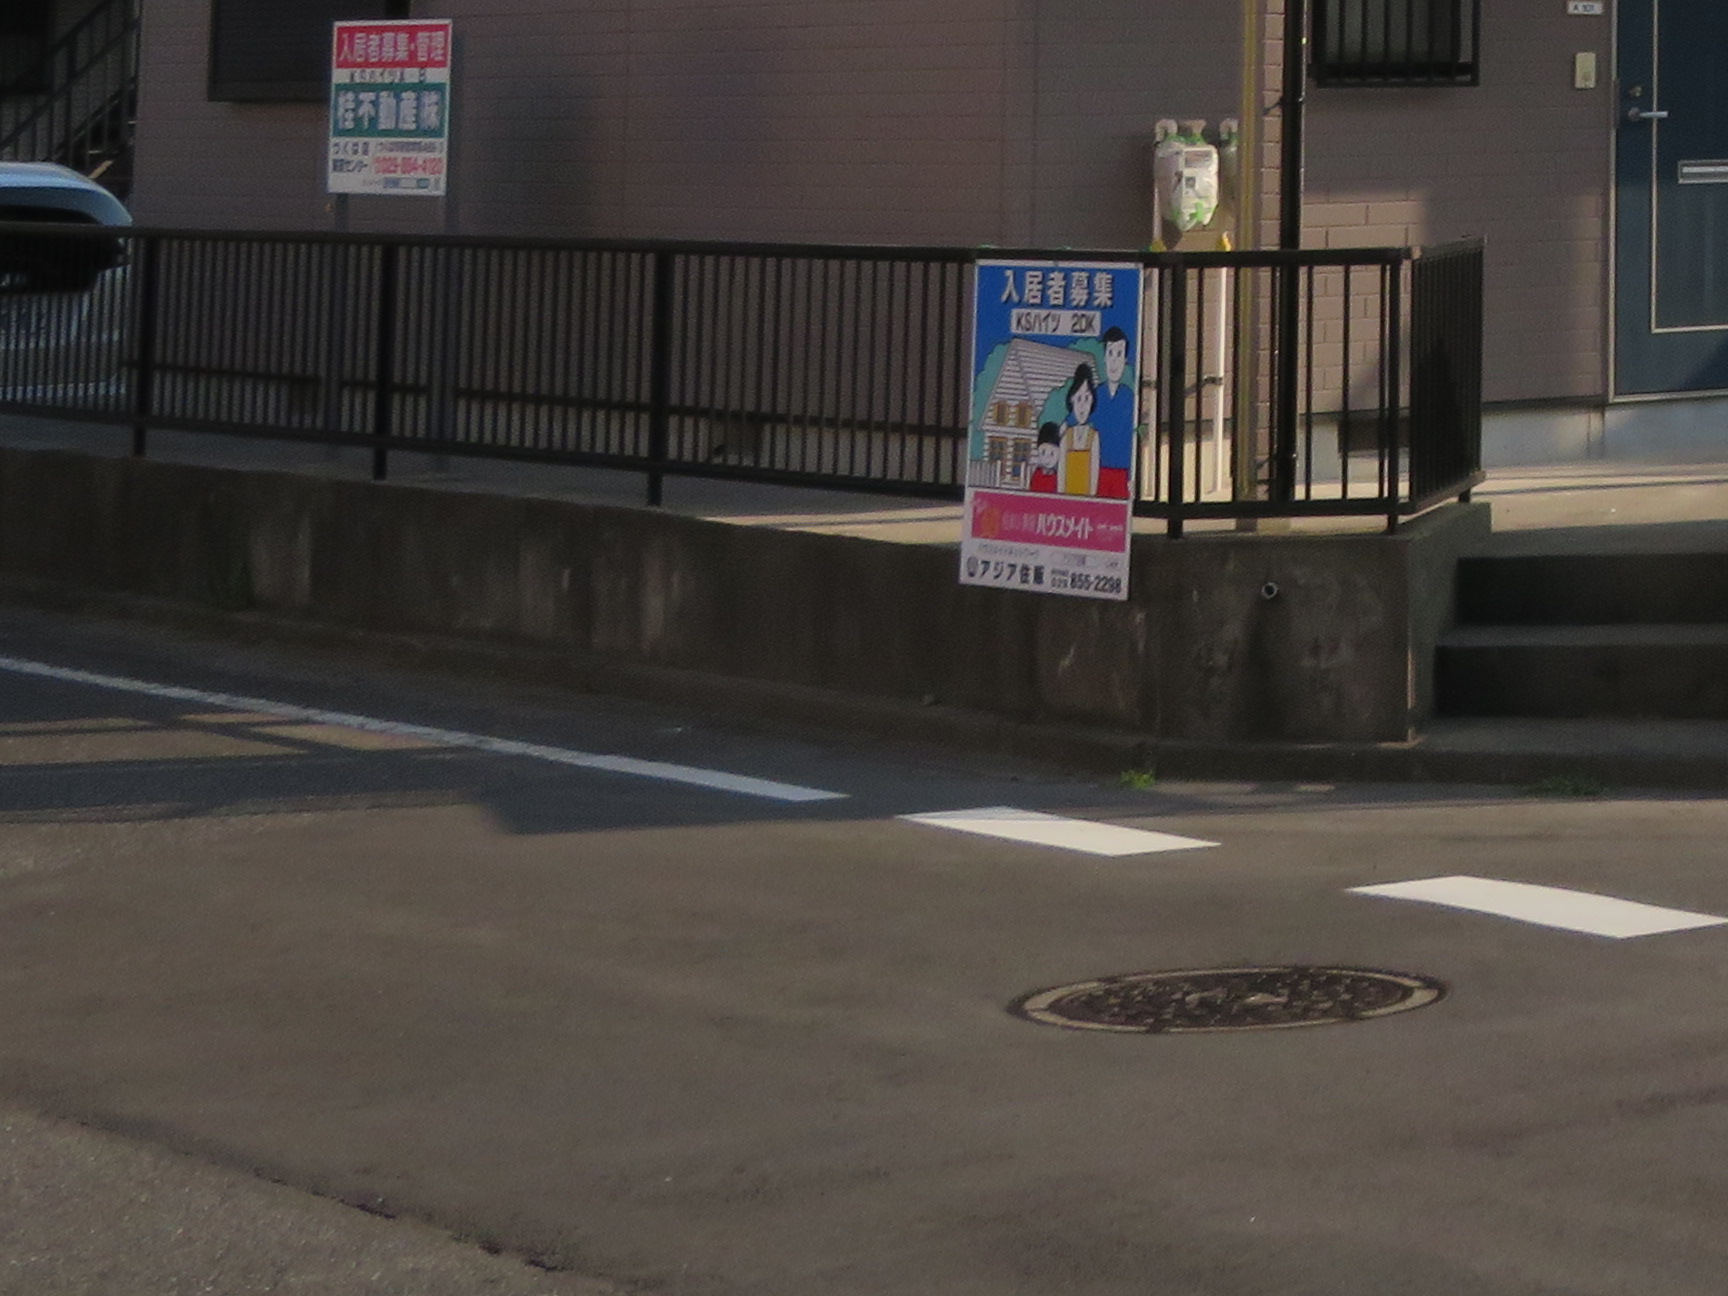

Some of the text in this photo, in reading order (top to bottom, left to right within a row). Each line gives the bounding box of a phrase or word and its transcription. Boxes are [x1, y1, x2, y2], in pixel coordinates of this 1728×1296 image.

[1000, 269, 1114, 307] 入居者募集
[1071, 313, 1096, 333] 2DK
[1036, 513, 1094, 540] ハウスメイト
